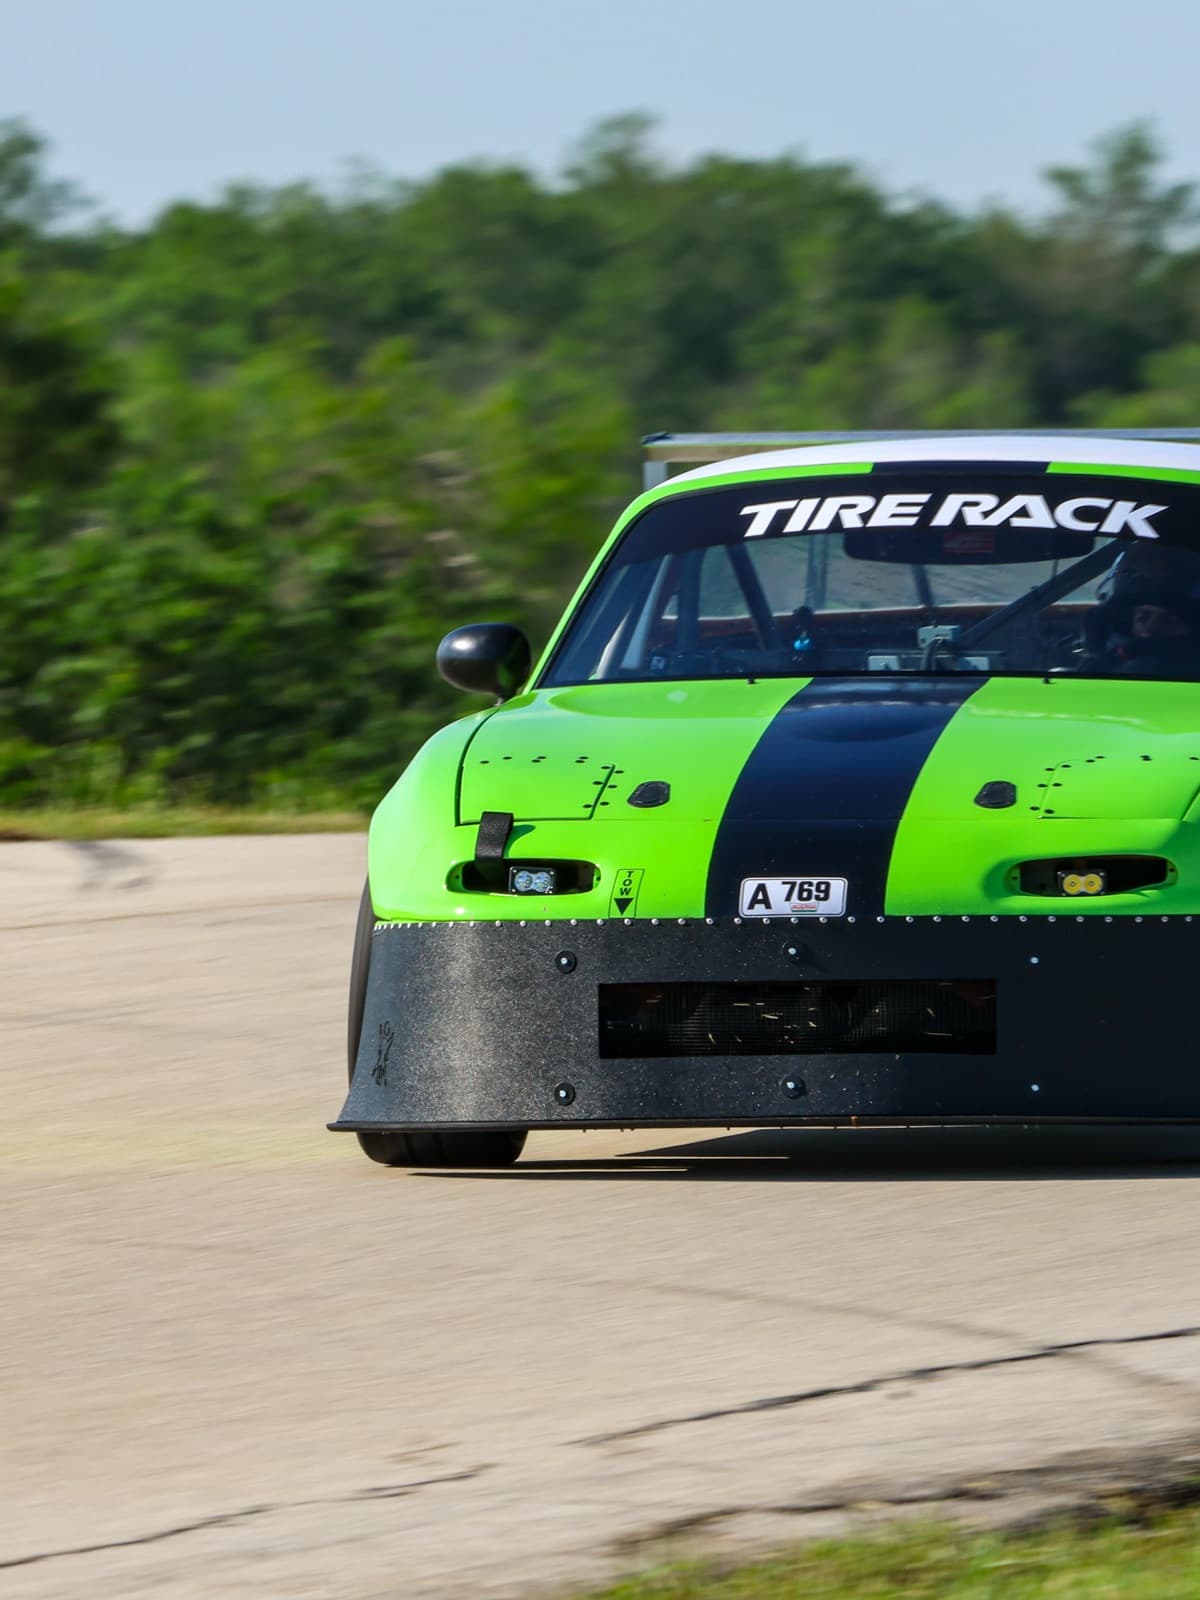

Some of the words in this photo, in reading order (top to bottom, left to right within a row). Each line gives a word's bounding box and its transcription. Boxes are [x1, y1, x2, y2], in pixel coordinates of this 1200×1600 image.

[739, 492, 933, 537] TIRE
[929, 494, 1169, 539] RACK
[620, 870, 635, 896] TOW
[747, 883, 773, 910] A
[781, 881, 831, 902] 769
